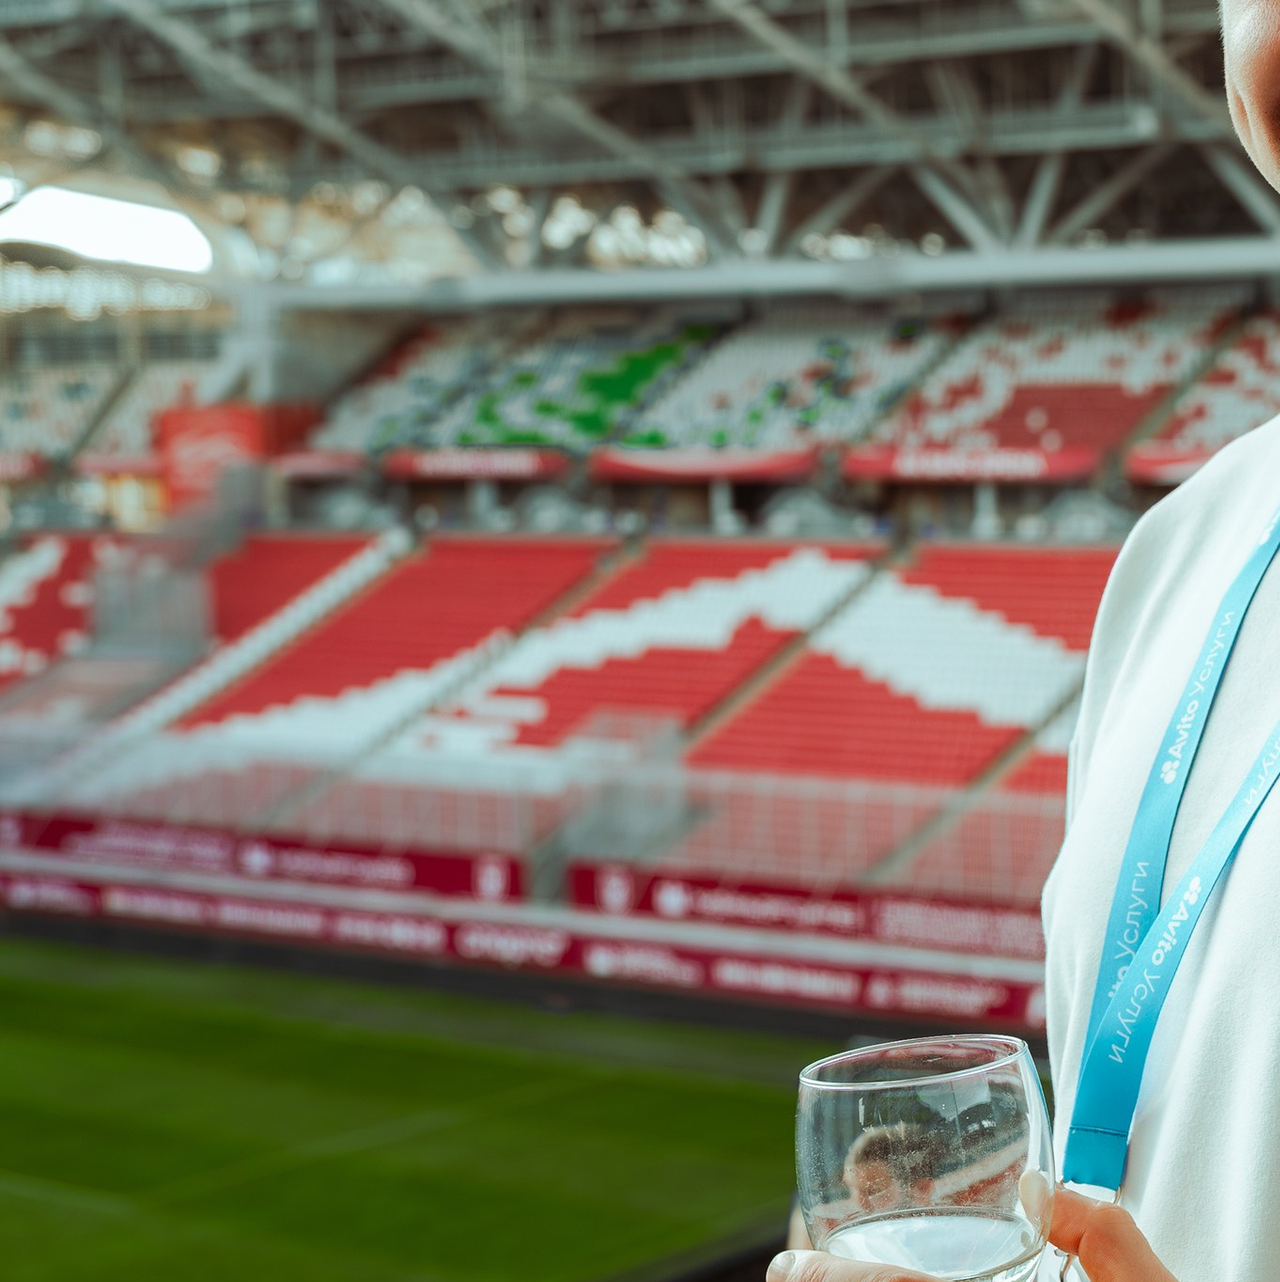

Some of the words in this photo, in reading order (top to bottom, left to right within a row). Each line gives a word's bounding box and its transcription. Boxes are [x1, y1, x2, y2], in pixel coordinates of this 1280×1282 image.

[1168, 700, 1199, 759] Avito
[1189, 611, 1235, 697] Услуги
[1114, 861, 1149, 959] Услуги
[1152, 902, 1189, 965] Avito
[1108, 968, 1161, 1064] Услуги
